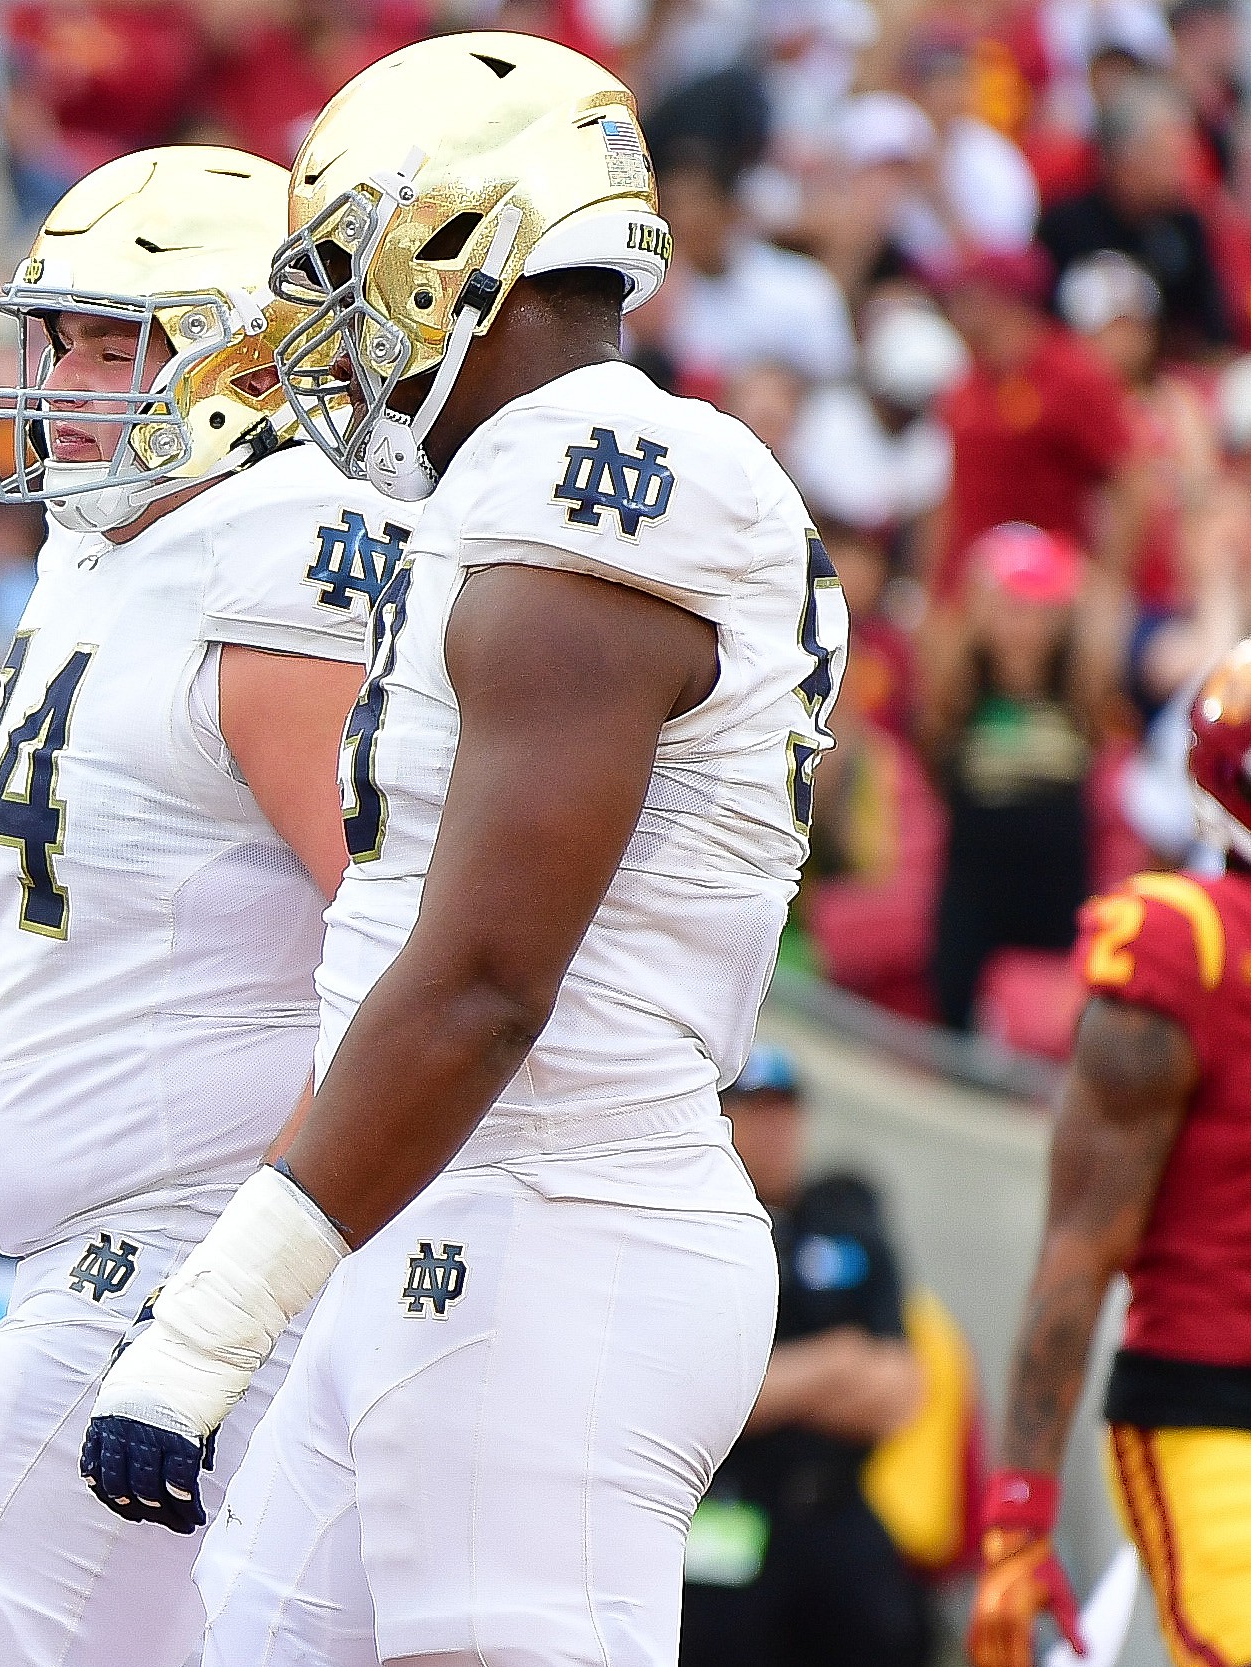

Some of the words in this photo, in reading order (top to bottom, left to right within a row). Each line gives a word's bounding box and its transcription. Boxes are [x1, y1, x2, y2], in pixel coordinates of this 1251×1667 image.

[550, 424, 677, 539] ND
[68, 1230, 140, 1304] ND
[401, 1241, 468, 1316] ND
